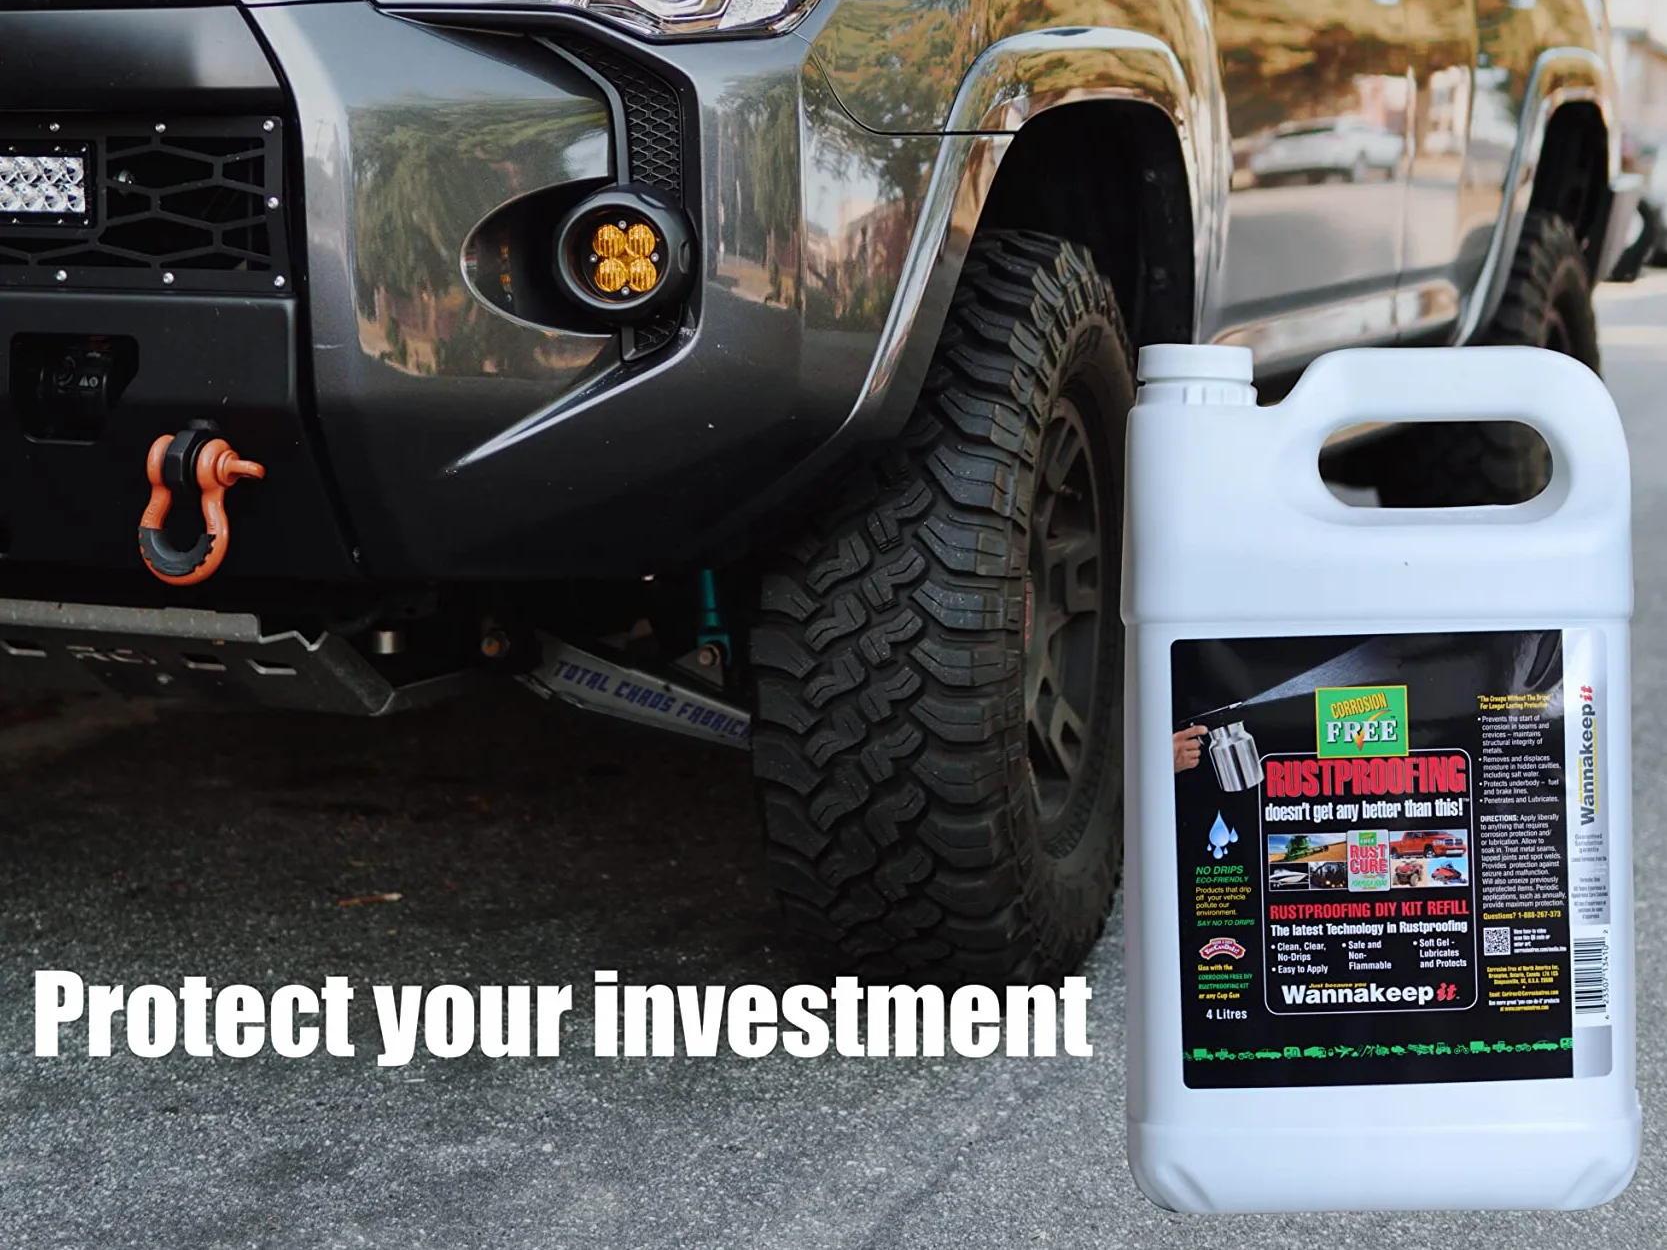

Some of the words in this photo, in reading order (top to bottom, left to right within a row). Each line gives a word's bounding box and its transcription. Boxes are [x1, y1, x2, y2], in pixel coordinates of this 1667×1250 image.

[554, 661, 609, 692] TOTAL
[614, 680, 676, 712] CHAOS
[1330, 692, 1388, 720] CORROSION
[1326, 719, 1398, 743] FREE
[1579, 704, 1596, 826] Wannakeep
[1265, 755, 1466, 797] RUSTPROOFING
[1265, 804, 1310, 822] doesn't
[1313, 803, 1333, 823] get
[1336, 805, 1359, 822] any
[1362, 800, 1401, 819] better
[1404, 800, 1432, 817] than
[1350, 844, 1387, 859] RUST
[1196, 866, 1211, 875] NO
[1213, 866, 1244, 874] DRIPS
[1350, 858, 1388, 873] CURE
[1239, 886, 1251, 894] drip
[1270, 903, 1370, 919] RUSTPROOFING
[1375, 902, 1397, 917] DIY
[1401, 901, 1422, 916] KIT
[1427, 900, 1469, 915] REFILL
[1271, 925, 1290, 936] The
[1293, 924, 1323, 936] latest
[1326, 922, 1384, 936] Technology
[1387, 921, 1396, 933] in
[1400, 920, 1467, 934] Rustproofing
[1278, 943, 1301, 951] Clean,
[1304, 942, 1326, 951] Clear,
[1420, 939, 1435, 947] Soft
[1436, 939, 1449, 947] Gel
[1278, 953, 1311, 962] No-Drips
[1420, 949, 1459, 958] Lubricates
[1278, 965, 1296, 974] Easy
[1307, 965, 1328, 974] Apply
[1348, 961, 1392, 970] Flammable
[1436, 959, 1467, 968] Protects
[1281, 983, 1434, 1005] Wannakeep
[1206, 1009, 1212, 1019] 4
[1217, 1009, 1247, 1019] Litres
